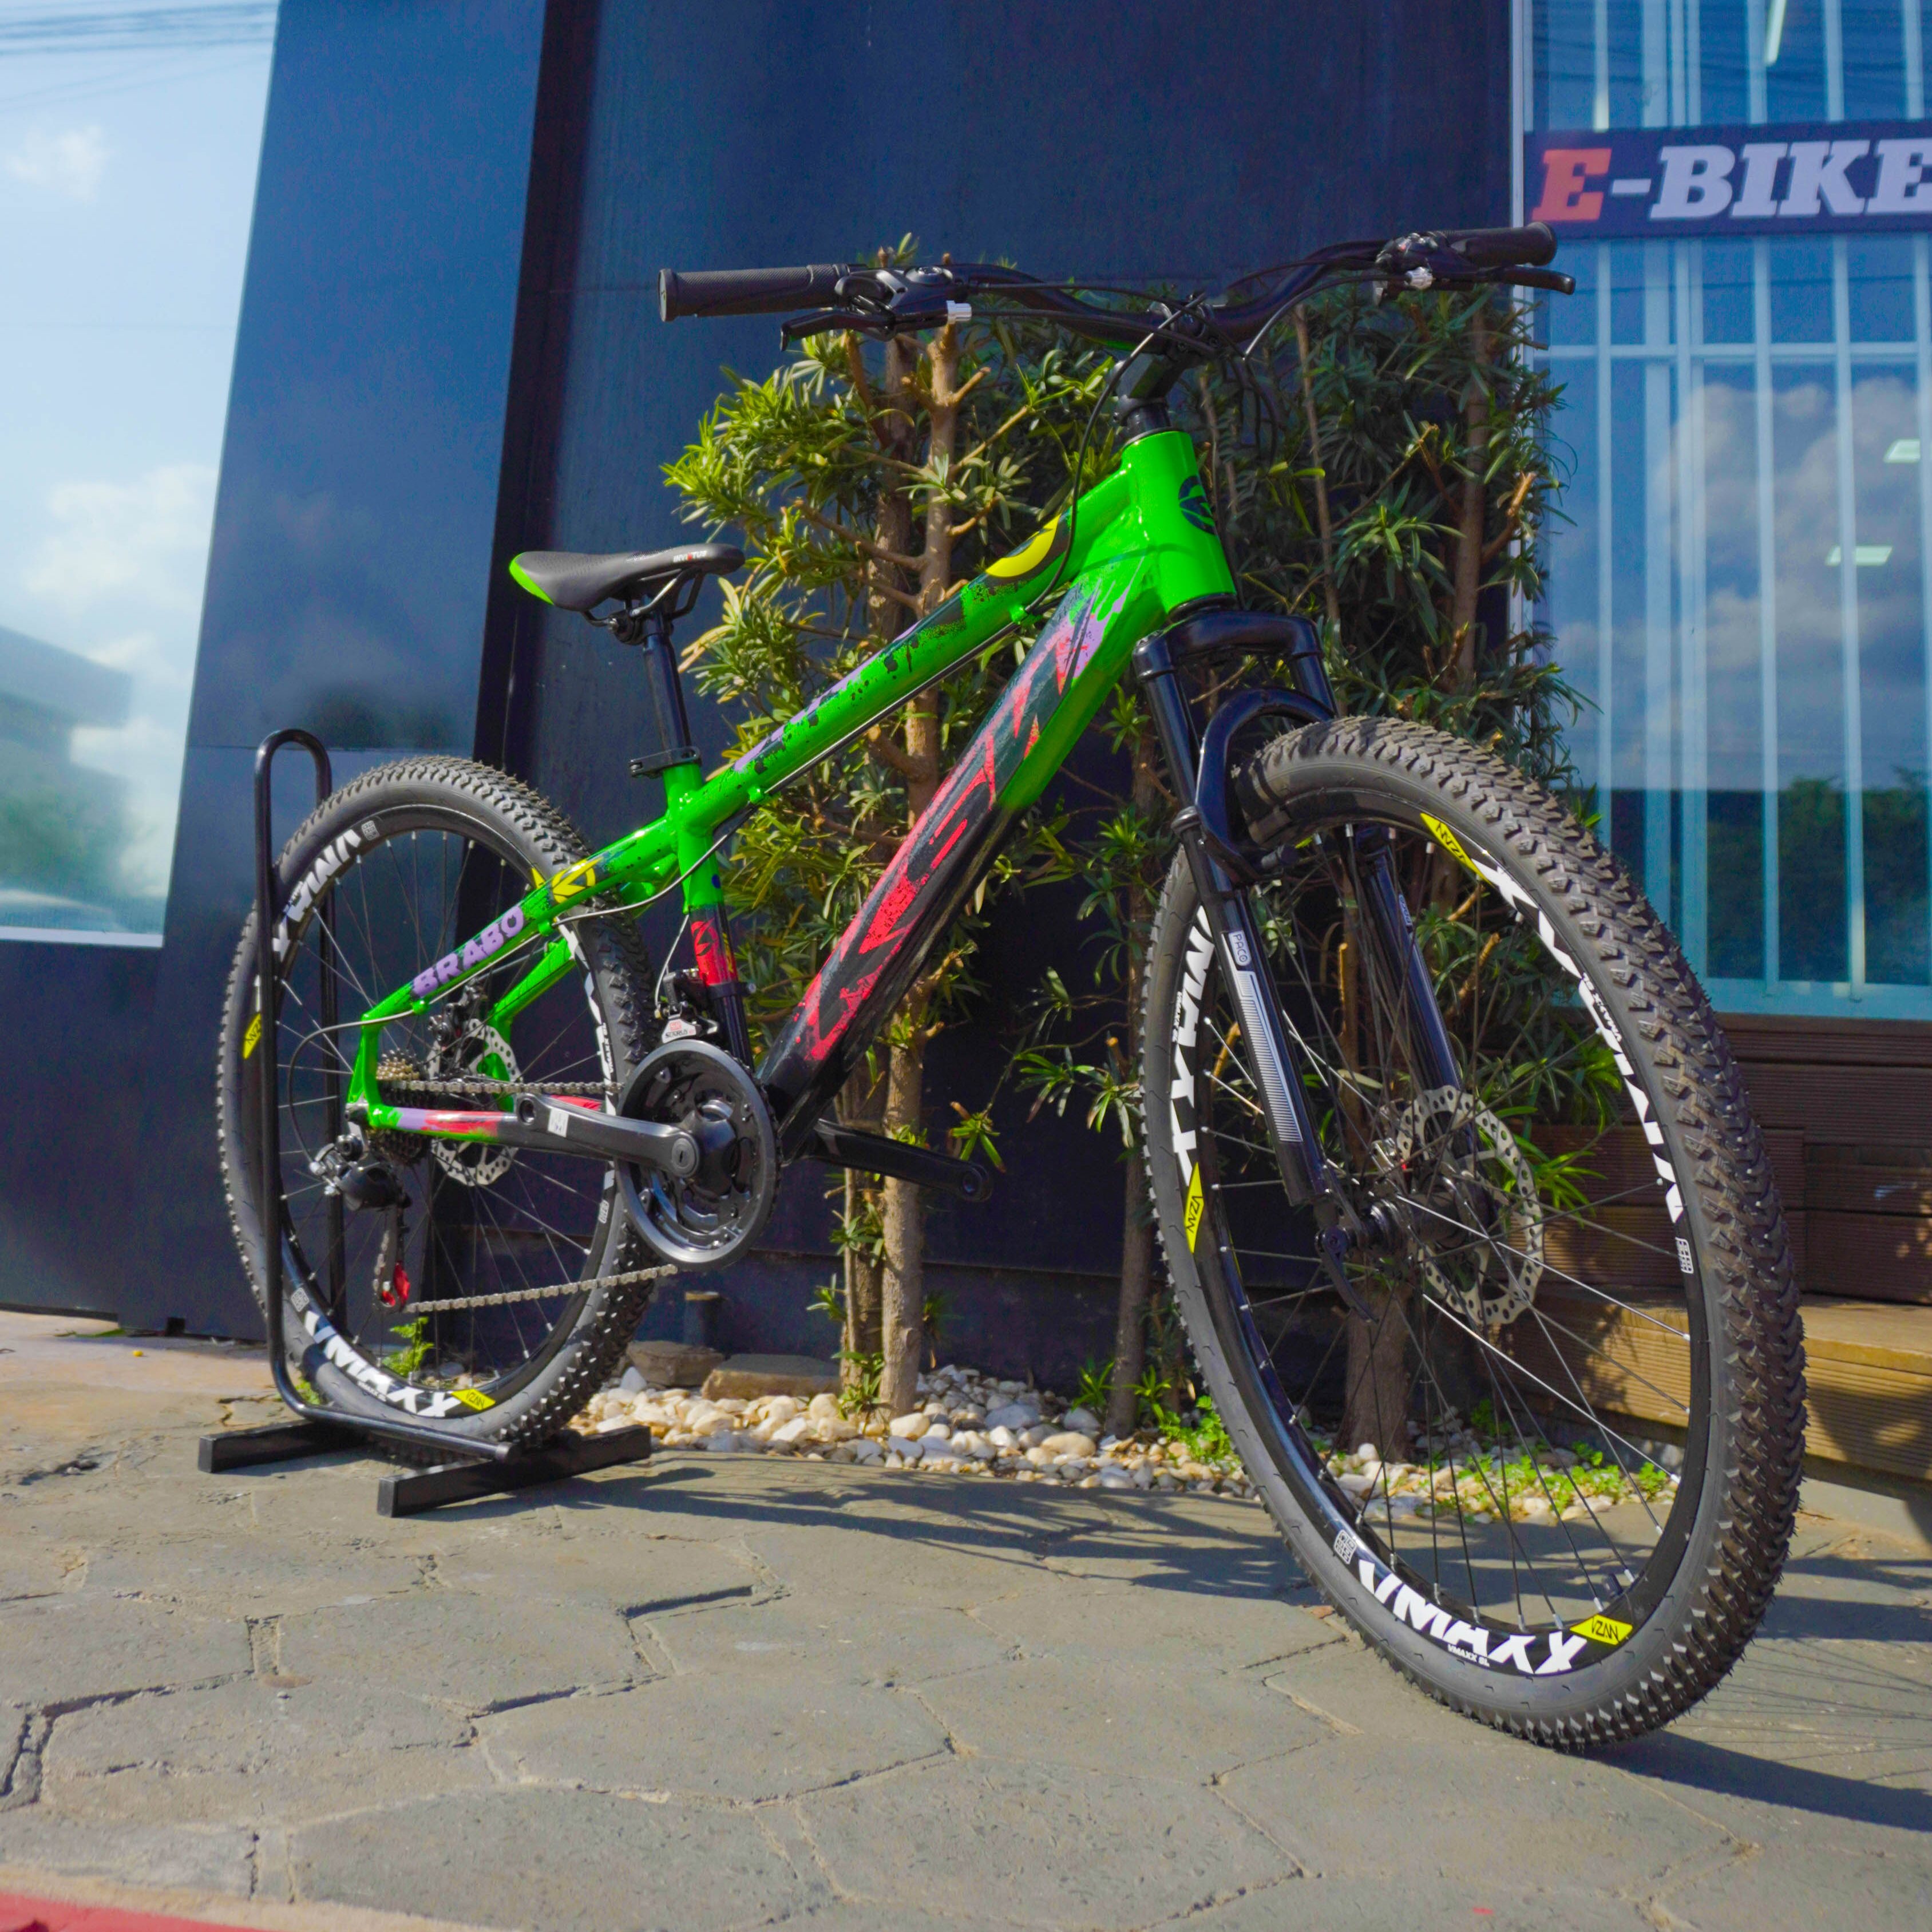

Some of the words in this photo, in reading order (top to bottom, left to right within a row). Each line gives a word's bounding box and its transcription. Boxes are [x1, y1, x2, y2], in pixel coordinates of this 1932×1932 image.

[1531, 138, 1932, 222] E-BIKE
[413, 905, 525, 997] BRABO
[1233, 933, 1249, 963] PACO
[1186, 1196, 1203, 1233] VZAN
[304, 1311, 461, 1418] VMAXX
[465, 1391, 485, 1408] VZAN
[1359, 1559, 1587, 1674] VMAXX
[1591, 1615, 1619, 1640] VZAN
[1447, 1644, 1478, 1661] VMAXX
[1477, 1655, 1490, 1667] SL
